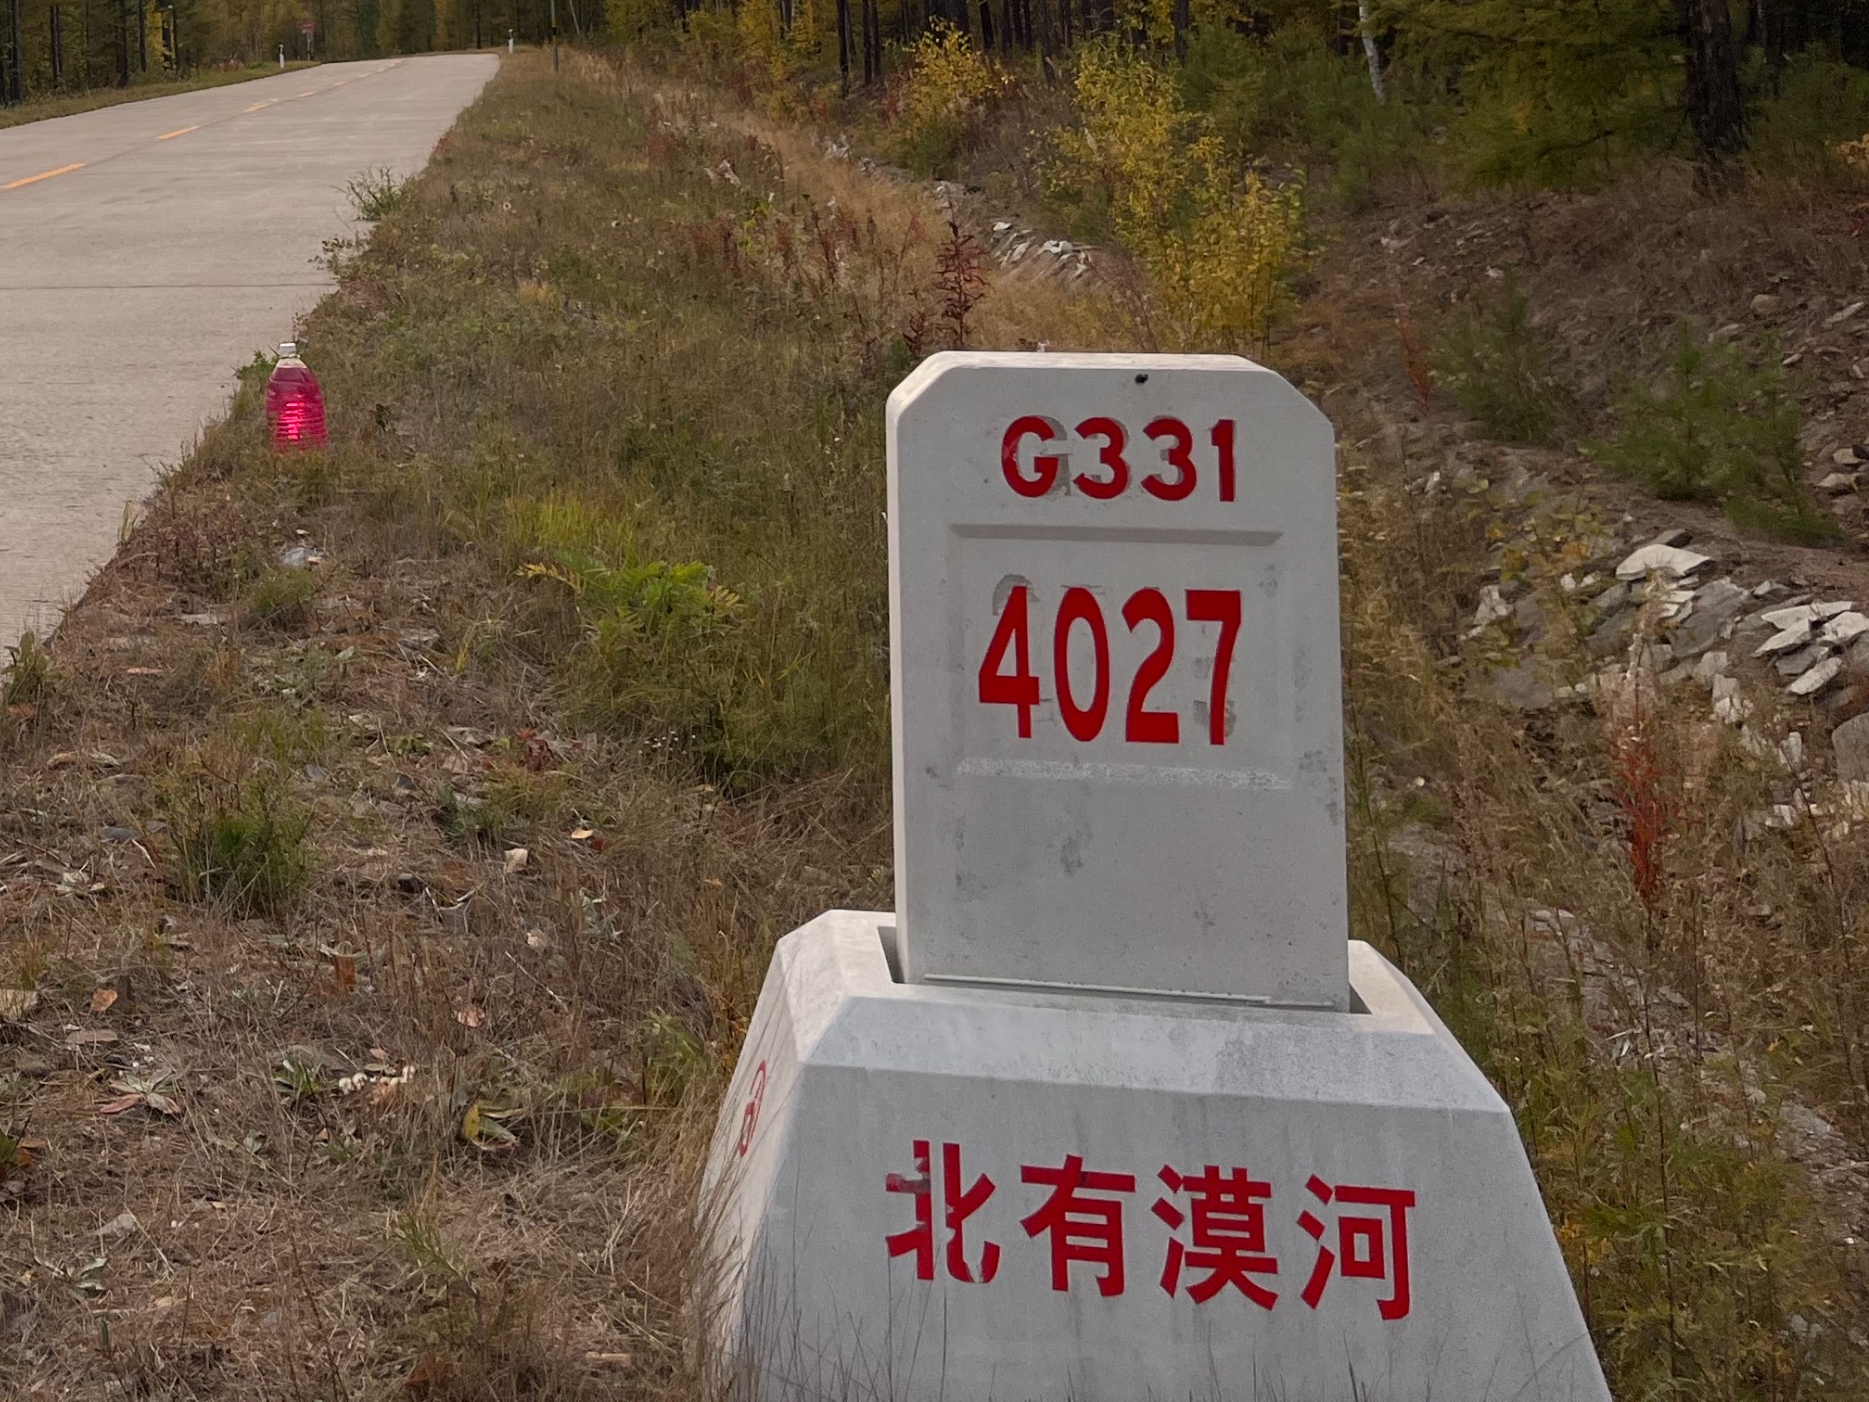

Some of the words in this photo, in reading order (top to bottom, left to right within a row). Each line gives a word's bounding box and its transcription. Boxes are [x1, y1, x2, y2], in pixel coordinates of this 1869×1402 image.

[1002, 416, 1235, 502] G331
[978, 585, 1242, 746] 4027
[886, 1139, 1416, 1321] 北有漠河
